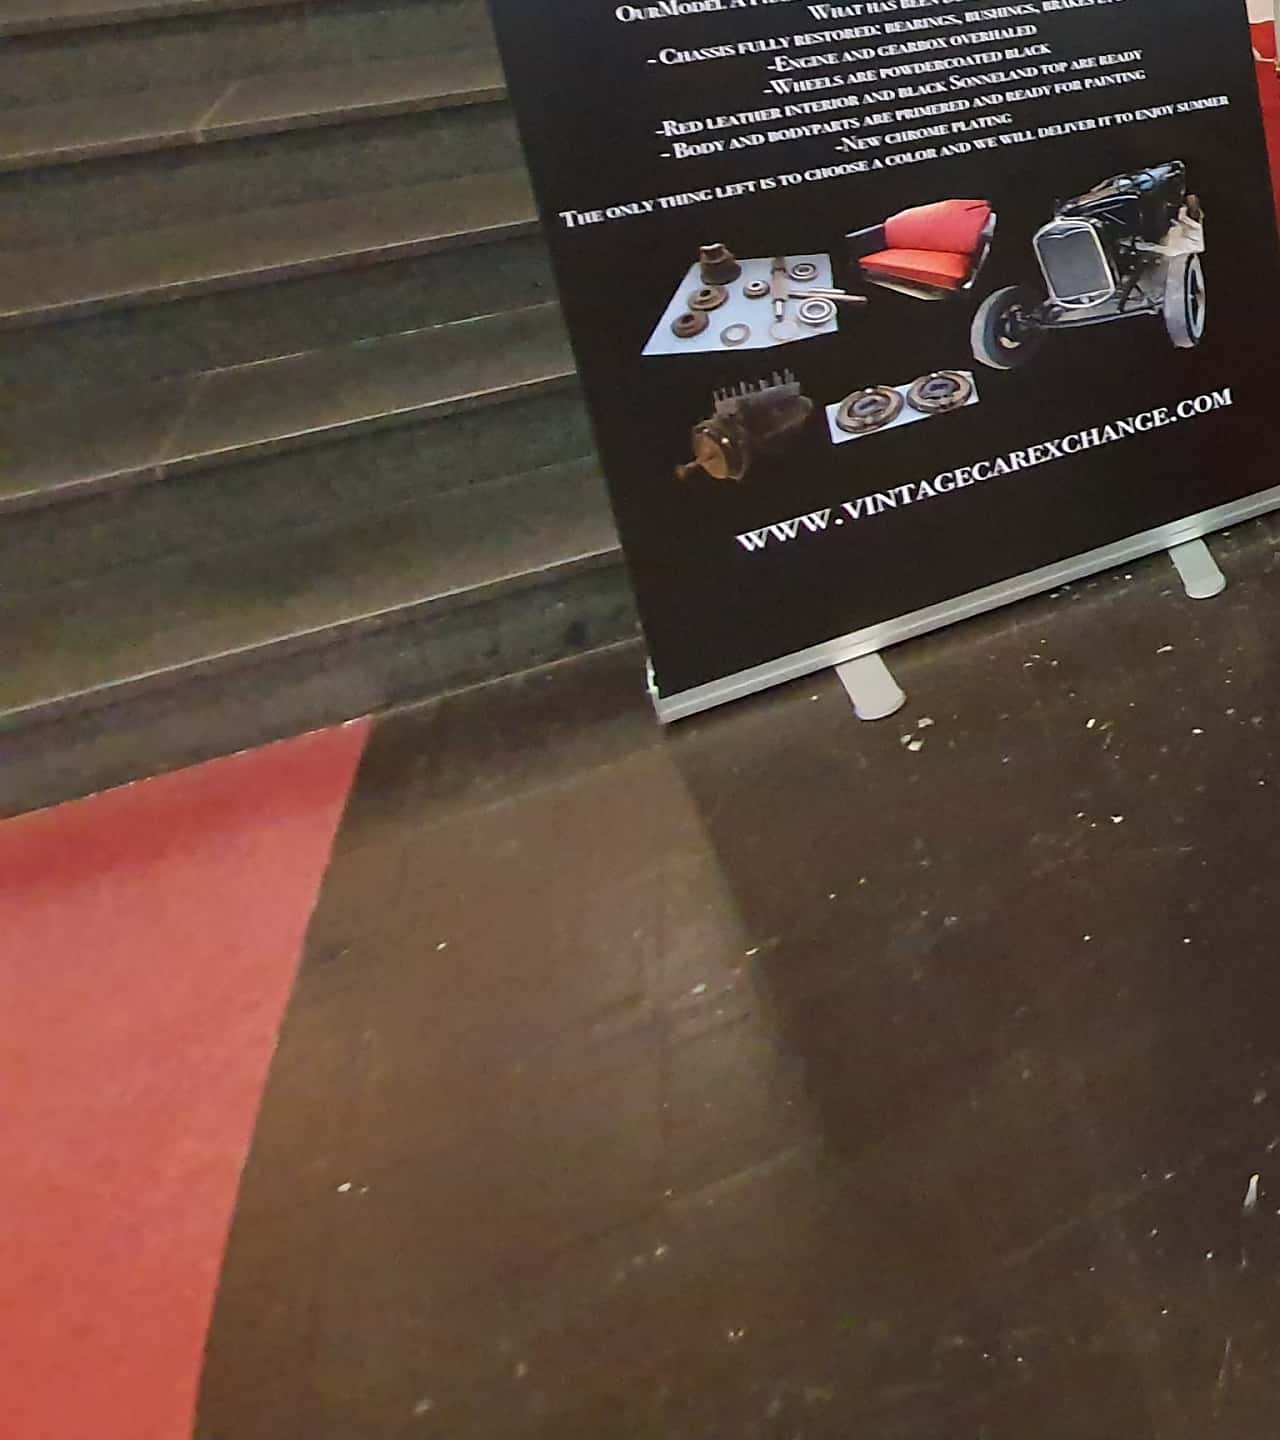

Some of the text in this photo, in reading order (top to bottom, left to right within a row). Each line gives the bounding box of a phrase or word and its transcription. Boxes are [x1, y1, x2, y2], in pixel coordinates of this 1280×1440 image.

[808, 3, 864, 20] WHAT
[866, 0, 898, 14] HAS
[658, 48, 735, 64] CHASSIS
[738, 37, 790, 54] FULLY
[843, 48, 875, 61] AND
[878, 37, 948, 56] GEARBOX
[951, 25, 1037, 46] OVERHALED
[847, 70, 878, 84] ARE
[880, 51, 1002, 79] POWDERCOATED
[1005, 43, 1052, 59] BLACK
[706, 107, 783, 129] LEATHER
[785, 95, 860, 114] INTERIOR
[863, 89, 896, 104] AND
[898, 80, 948, 98] BLACK
[1041, 63, 1068, 75] TOP
[1070, 58, 1098, 70] ARE
[1099, 50, 1143, 66] READY
[672, 140, 726, 159] BODY
[730, 133, 766, 149] AND
[768, 117, 861, 142] BODYPARTS
[863, 111, 894, 126] ARE
[972, 93, 1004, 107] AND
[1005, 85, 1053, 101] READY
[1054, 80, 1083, 93] FOR
[1084, 70, 1147, 89] PAINTING
[884, 124, 950, 144] CHROME
[951, 112, 1013, 133] PLATING
[558, 94, 1230, 228] THE ONLY THING LEFT IS TO CHOOSE A COLOR AND WE WILL DELIVER IT TO ENJOY SUMMER
[736, 387, 1234, 553] WWW.VINTAGECAREXCHANGE.COM
